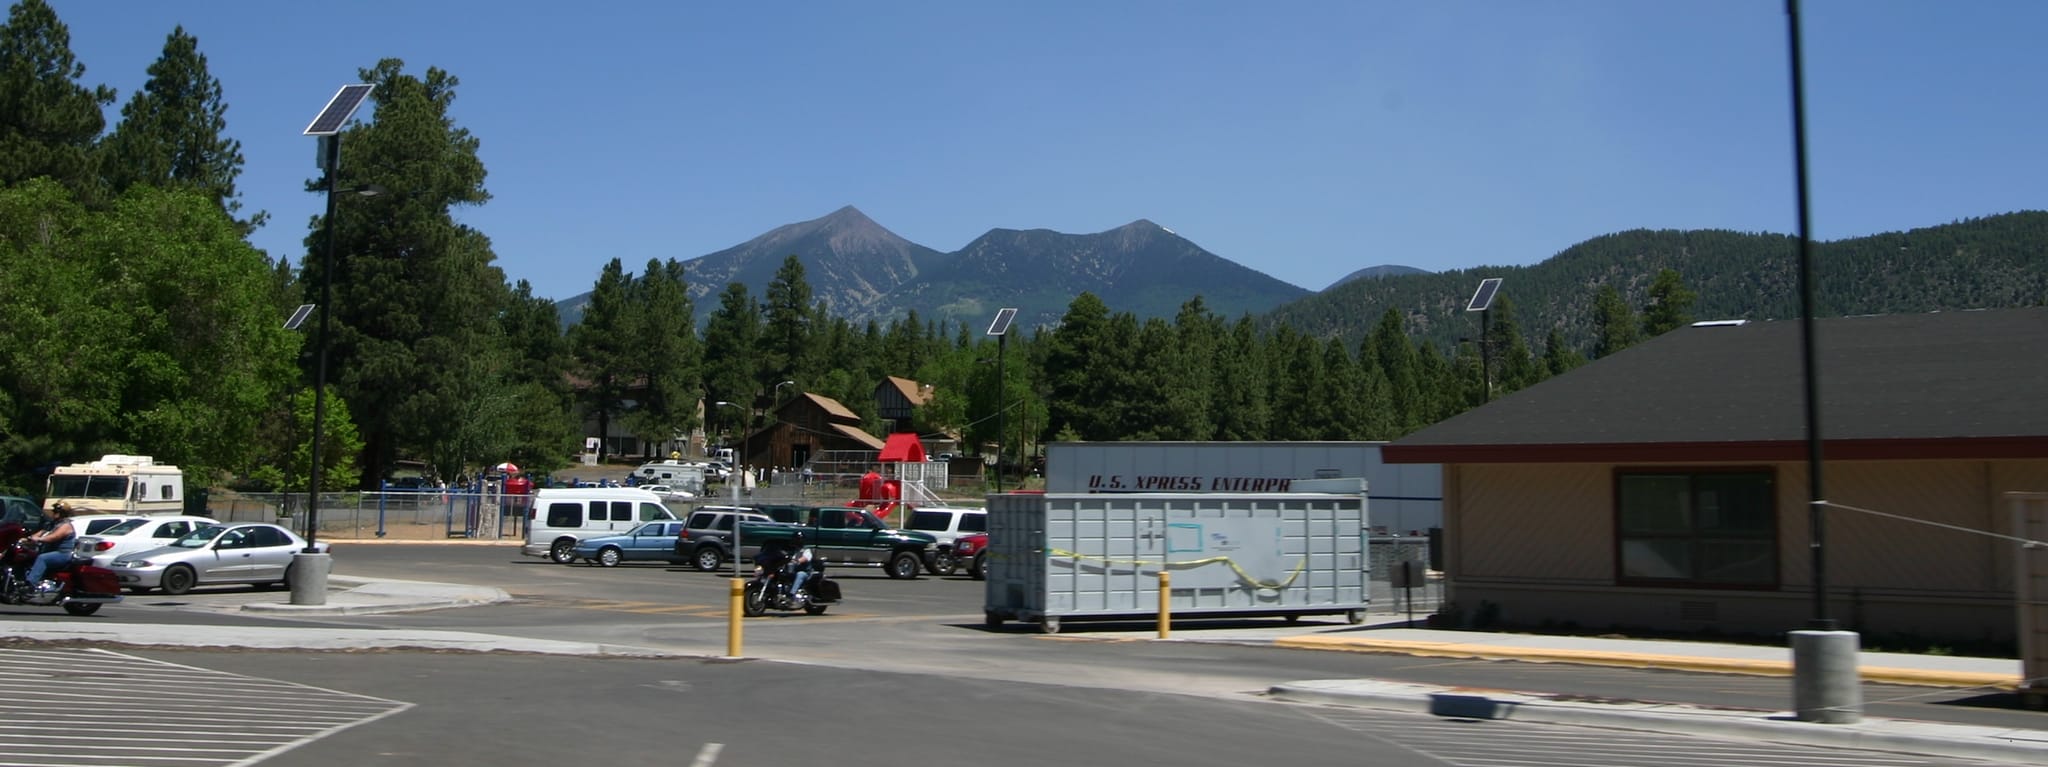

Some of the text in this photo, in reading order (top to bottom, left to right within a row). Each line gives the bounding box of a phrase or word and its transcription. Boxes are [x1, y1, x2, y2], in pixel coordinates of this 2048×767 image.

[1088, 474, 1294, 492] U.S. XPRESS ENTERPR
